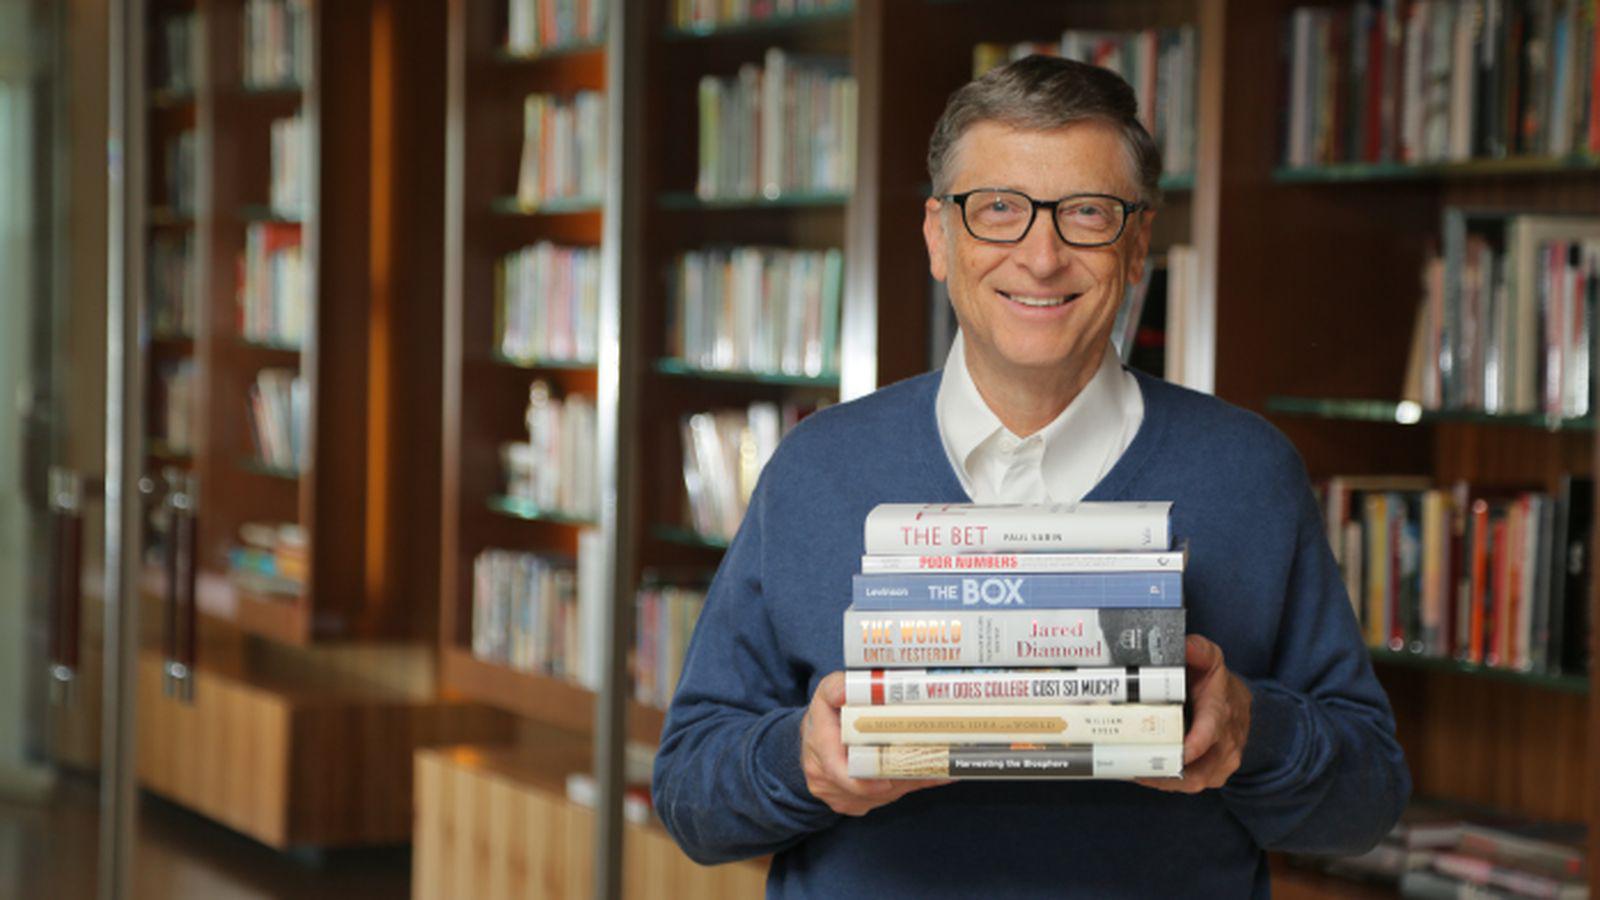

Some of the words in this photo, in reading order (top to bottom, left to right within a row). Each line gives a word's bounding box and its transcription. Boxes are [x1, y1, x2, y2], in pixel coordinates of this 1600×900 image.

[901, 526, 942, 545] THE
[951, 526, 988, 545] BET
[1003, 533, 1028, 541] PAUL
[918, 555, 952, 569] POOR
[955, 555, 1018, 568] NUMBERS
[866, 587, 909, 597] Levinson
[928, 585, 958, 600] THE
[962, 578, 1025, 605] BOX
[860, 619, 893, 644] THE
[899, 619, 962, 644] WORLD
[1028, 621, 1083, 638] Jared
[863, 647, 896, 663] UNTIL
[900, 647, 961, 663] YESTERDAY
[1017, 641, 1102, 657] Diamond
[927, 682, 949, 699] WHY
[953, 682, 982, 699] DOES
[984, 681, 1029, 698] COLLEGE
[1032, 680, 1060, 697] COST
[1062, 680, 1079, 697] SO
[1081, 679, 1120, 697] MUCH?
[955, 760, 1003, 771] Harvesting
[1006, 760, 1021, 768] the
